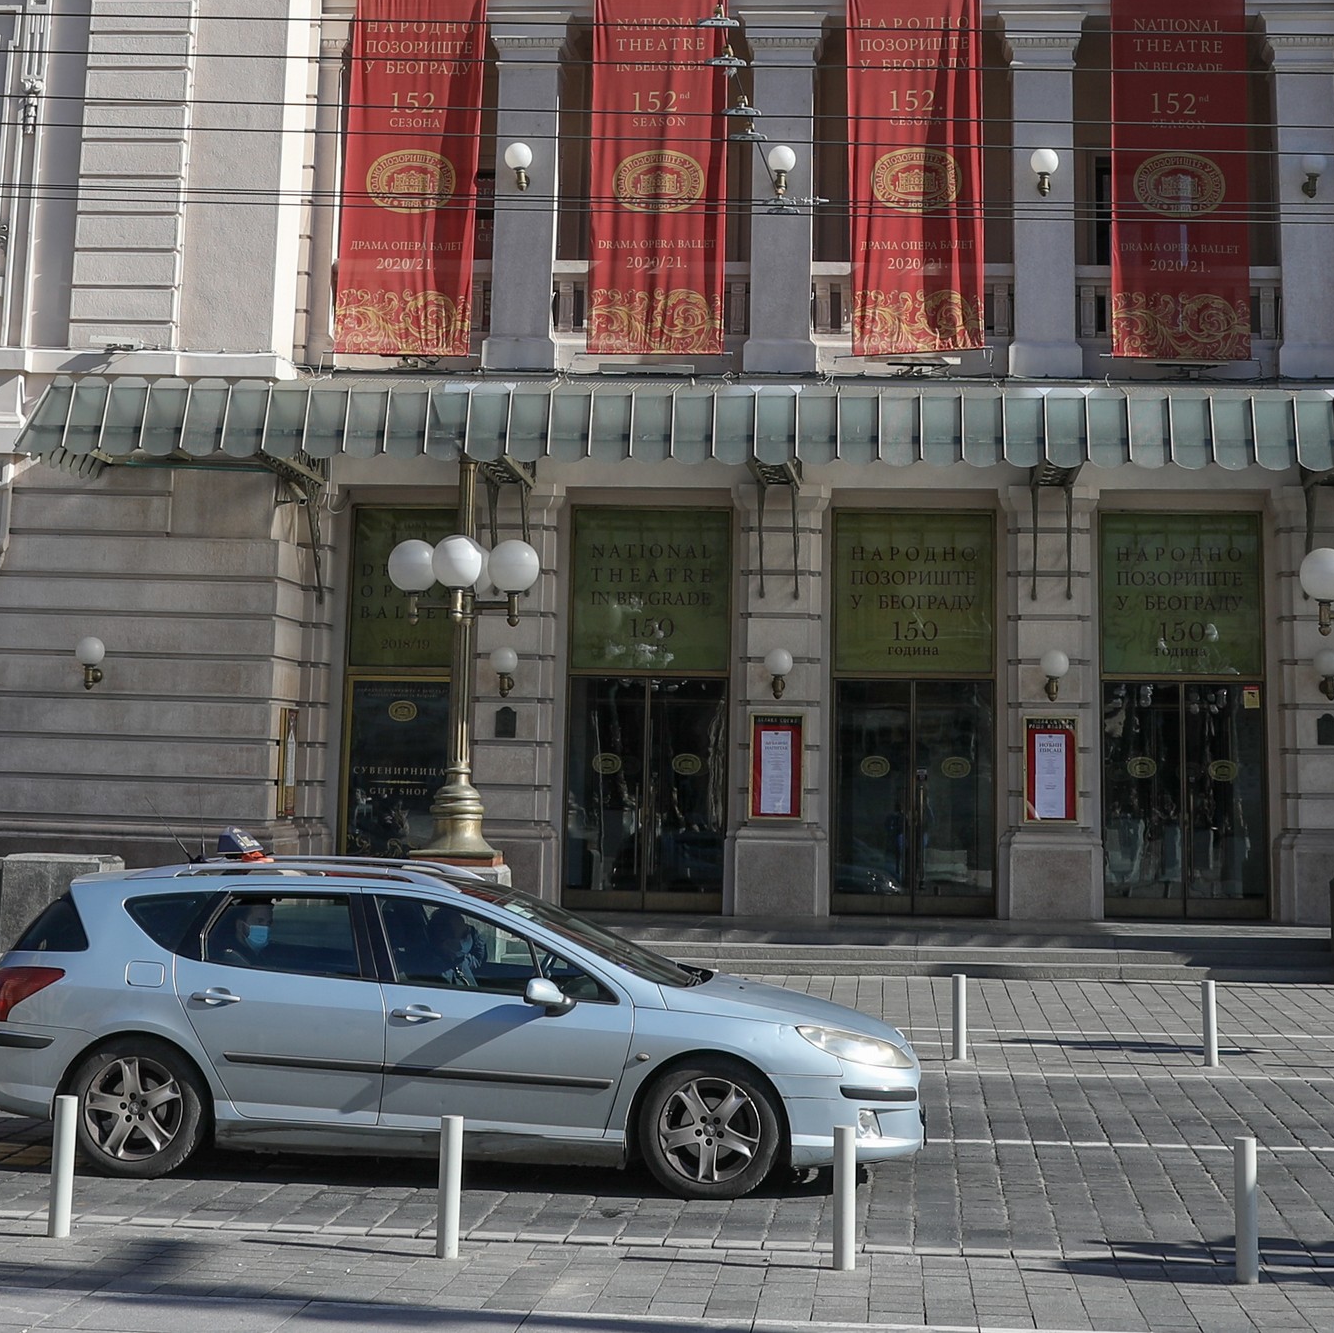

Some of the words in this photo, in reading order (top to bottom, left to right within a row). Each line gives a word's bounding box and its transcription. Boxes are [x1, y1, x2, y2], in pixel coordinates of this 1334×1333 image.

[366, 21, 474, 35] НАРОДНО
[859, 17, 969, 31] НАРОДНО
[1133, 19, 1223, 33] NATIONAL
[365, 40, 473, 54] ПОЗОРИШТЕ
[616, 38, 705, 51] THEATRE
[859, 37, 969, 52] ПОЗОРИШТЕ
[1133, 39, 1223, 53] THEATRE
[364, 61, 375, 74] У
[385, 61, 472, 76] БЕОГРАДУ
[889, 90, 943, 112] 152.
[389, 118, 440, 127] СЕЗОНА
[632, 117, 686, 127] SEASON
[350, 240, 389, 251] ДРАМА
[391, 241, 426, 250] ОПЕРА
[430, 241, 464, 251] БАЛЕТ
[598, 240, 637, 249] DRAMA
[640, 240, 675, 249] OPERA
[678, 239, 716, 249] BALLET
[860, 241, 898, 251] ДРАМА
[901, 240, 937, 250] ОПЕРА
[1120, 243, 1161, 252] DRAMA
[1163, 243, 1198, 253] OPERA
[1201, 243, 1240, 254] BALLET
[591, 544, 712, 559] NATIONAL
[851, 546, 976, 564] НАРОДНО
[1116, 547, 1242, 564] НАРОДНО
[591, 568, 712, 583] THEATRE
[851, 570, 976, 586] ПОЗОРИШТЕ
[1116, 571, 1243, 586] ПОЗОРИШТЕ
[591, 591, 609, 605] IN
[850, 595, 863, 610] У
[879, 595, 977, 612] БЕОГРАДУ
[1116, 595, 1129, 611] У
[1144, 595, 1243, 613] БЕОГРАДУ
[892, 620, 938, 641] 150
[1159, 621, 1206, 643] 150
[888, 646, 939, 657] година
[1154, 647, 1207, 657] година
[353, 766, 445, 776] СУВЕНИРНИЦА
[399, 788, 428, 796] SHOP
